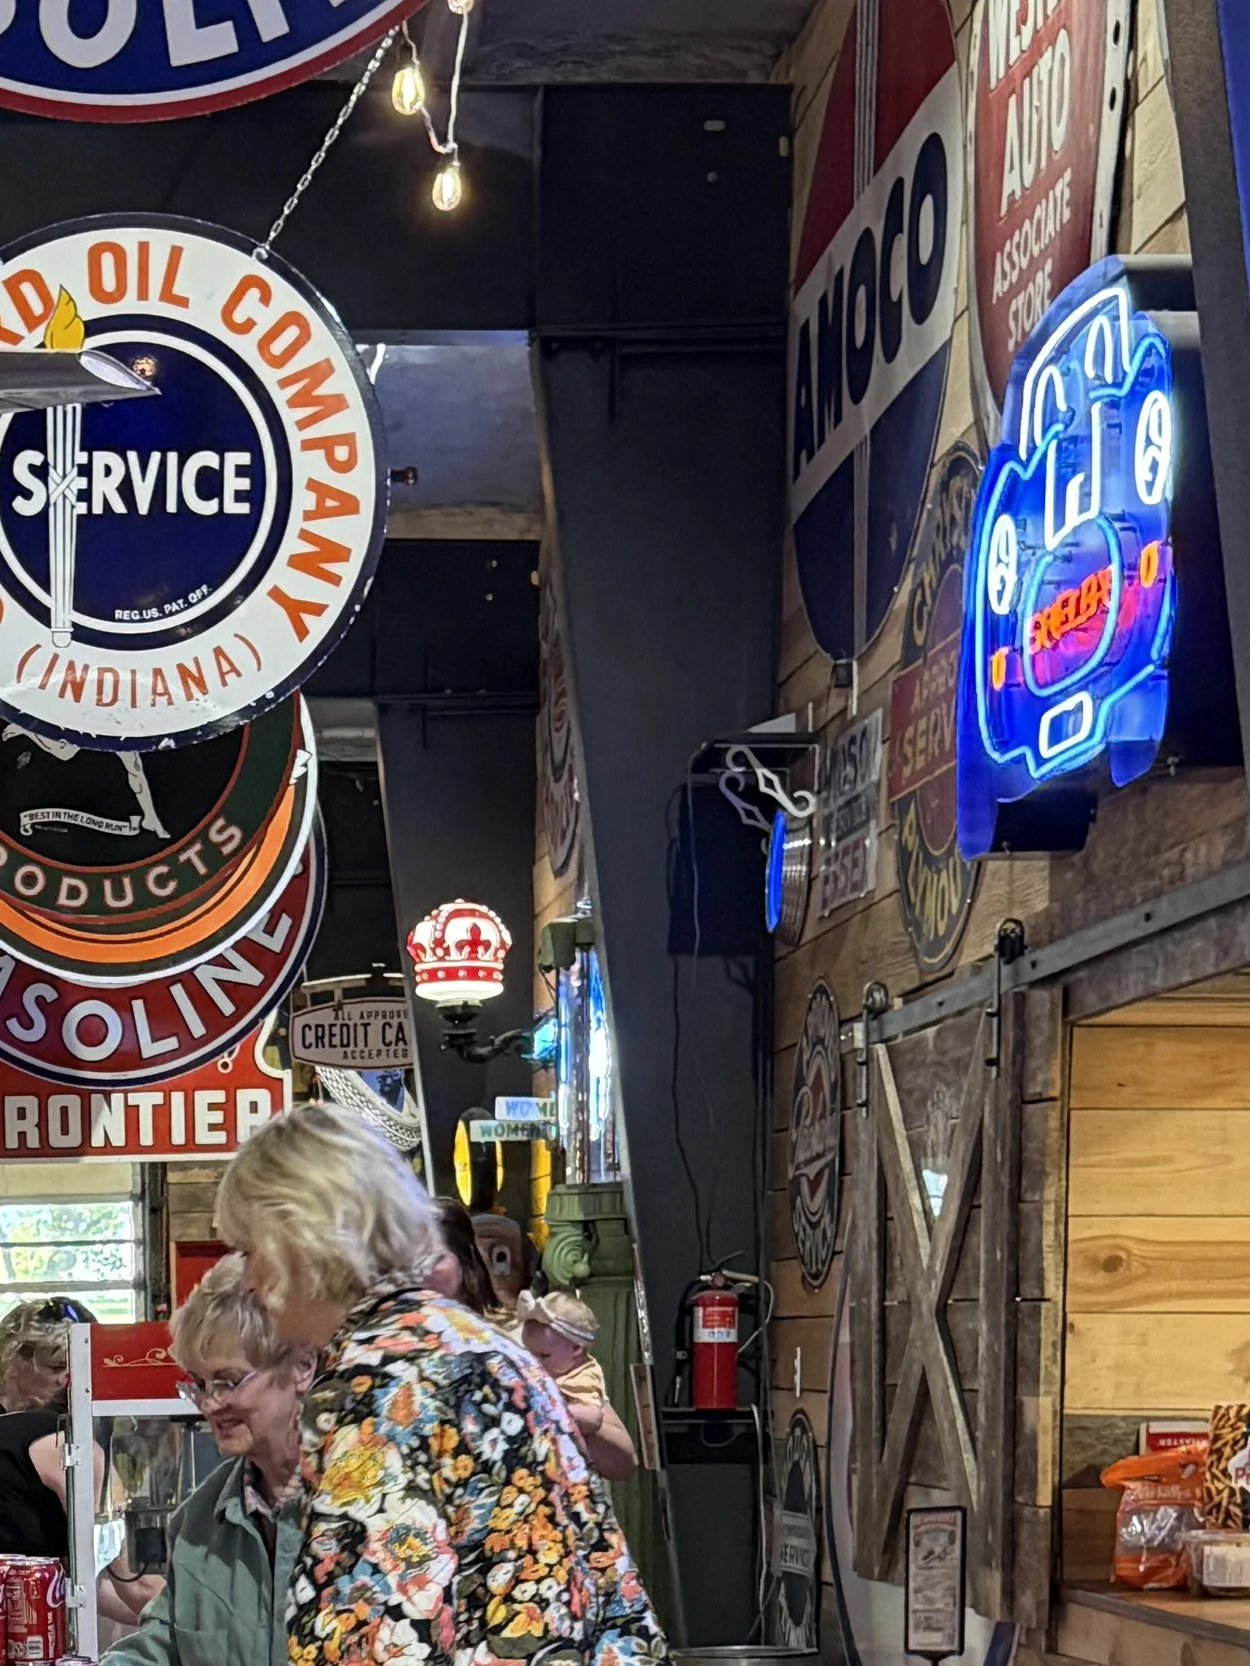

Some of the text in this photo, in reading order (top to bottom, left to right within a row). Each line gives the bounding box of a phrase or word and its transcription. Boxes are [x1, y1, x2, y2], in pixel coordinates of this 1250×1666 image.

[1000, 27, 1070, 218] AUTO
[992, 166, 1072, 305] ASSOCIATE
[792, 130, 949, 485] AMOCO
[11, 450, 252, 517] SERVICE
[87, 239, 191, 310] OIL
[220, 272, 361, 644] COMPANY
[15, 631, 263, 711] (INDIANA)
[902, 700, 959, 780] SERV
[301, 1022, 371, 1050] CREDIT
